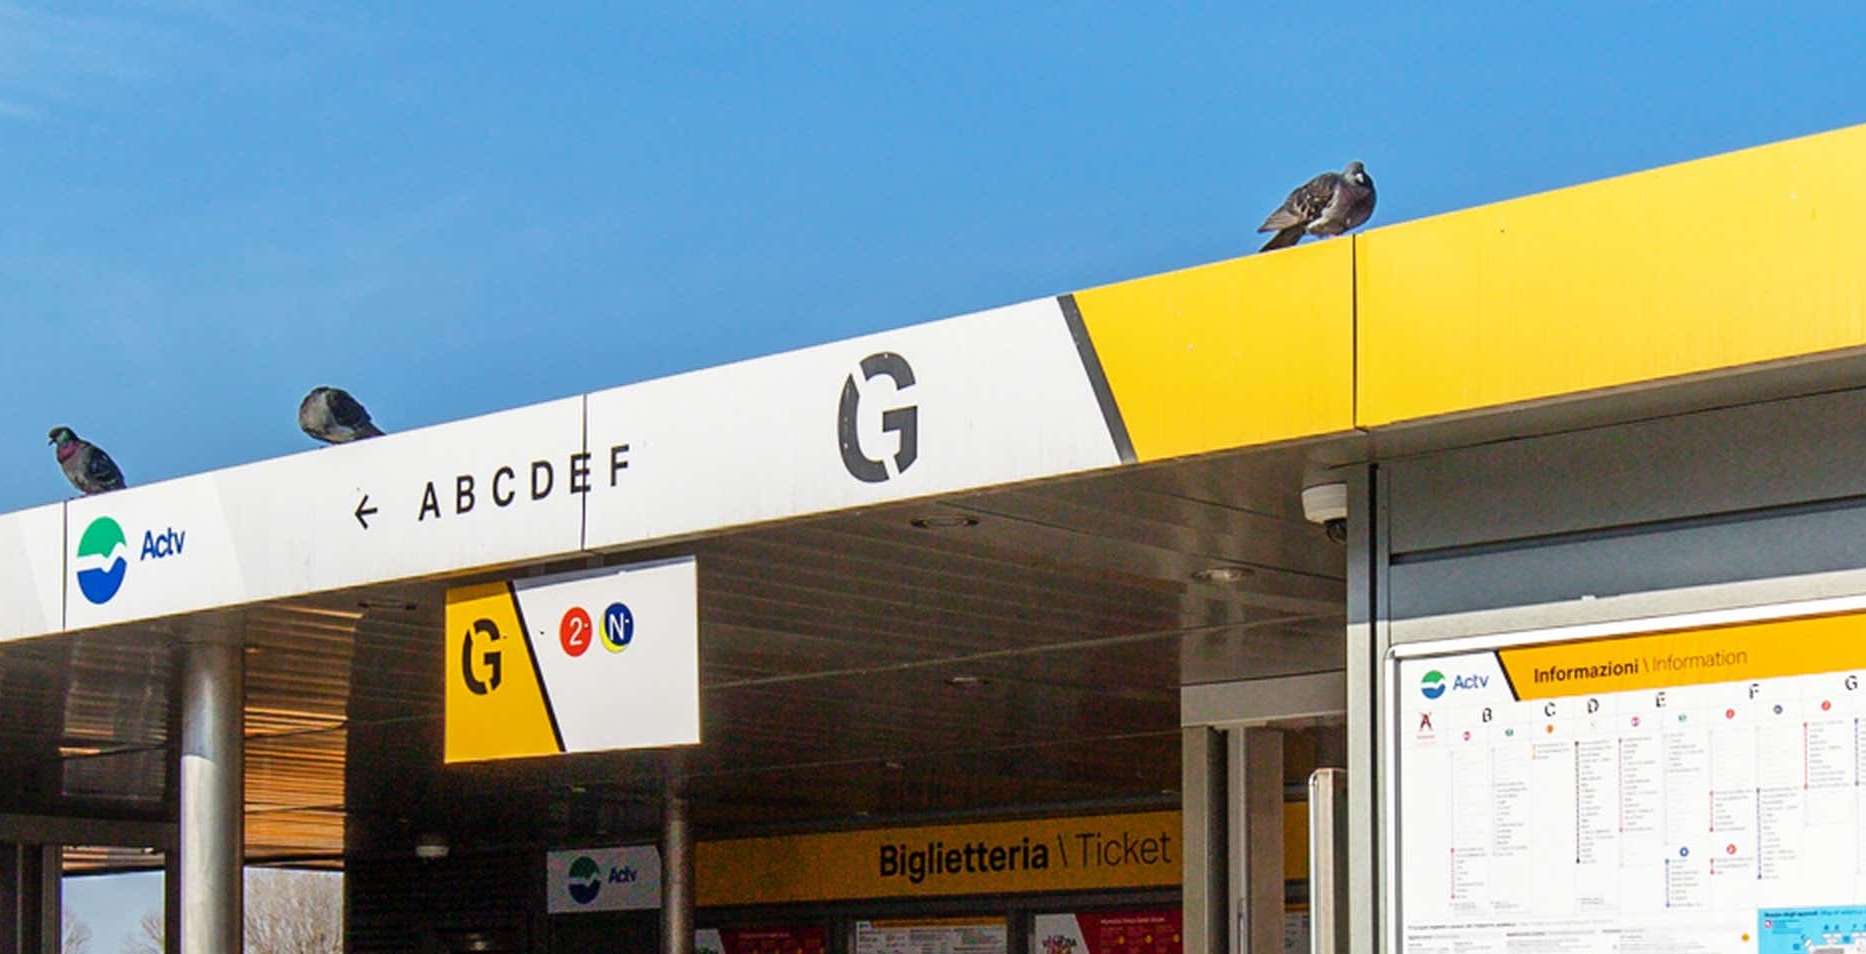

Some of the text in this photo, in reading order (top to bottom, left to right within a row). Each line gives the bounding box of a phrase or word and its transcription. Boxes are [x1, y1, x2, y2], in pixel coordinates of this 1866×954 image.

[838, 351, 918, 483] G
[139, 526, 185, 561] Actv
[569, 612, 626, 646] 2 N
[461, 618, 502, 695] G
[1534, 660, 1640, 684] Informazioni
[1653, 650, 1749, 672] Information
[1452, 675, 1489, 691] Actv
[1544, 701, 1557, 718] C
[1587, 698, 1600, 714] D
[880, 836, 1050, 884] Biglietteria
[1075, 831, 1173, 867] Ticket
[608, 866, 637, 887] Actv
